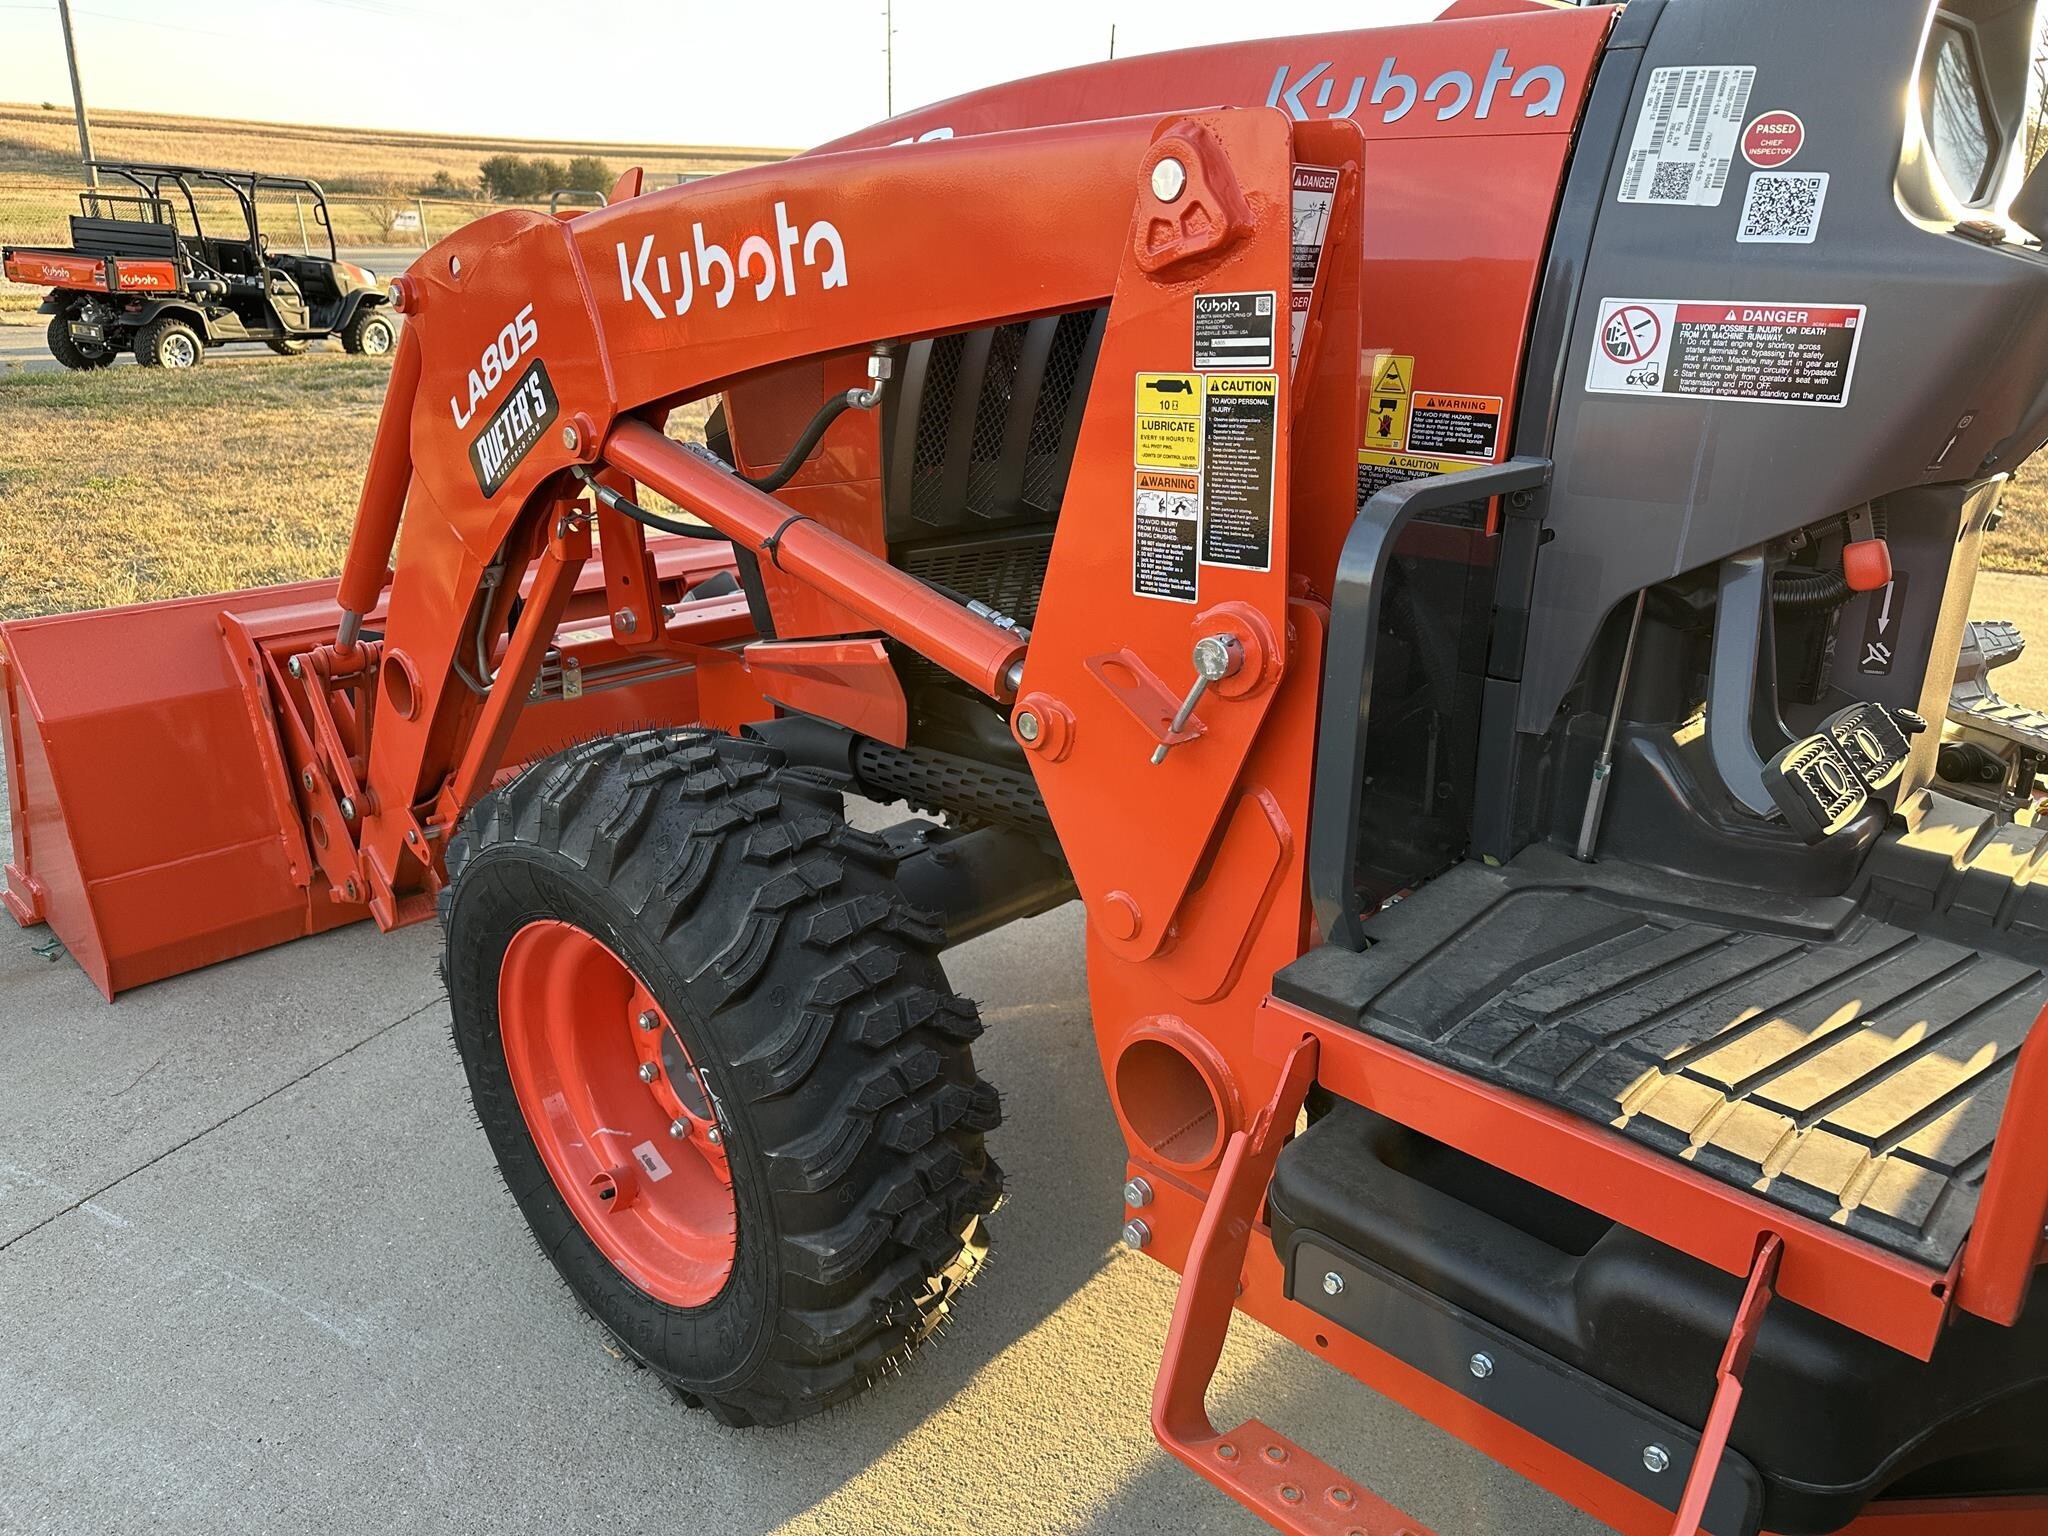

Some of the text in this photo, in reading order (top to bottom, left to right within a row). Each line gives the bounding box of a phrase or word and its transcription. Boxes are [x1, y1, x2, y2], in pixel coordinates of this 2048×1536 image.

[1265, 48, 1566, 123] Kubota
[1756, 124, 1796, 134] PASSED
[1302, 175, 1335, 188] DANGER
[616, 201, 848, 319] Kubota
[42, 265, 70, 278] Kubota
[121, 274, 158, 284] Kubota
[1196, 298, 1239, 312] Kubota
[1292, 296, 1308, 307] GER
[1742, 309, 1808, 323] DANGER
[1757, 326, 1783, 334] INJURY
[1747, 333, 1784, 341] RUNAWAY.
[1768, 342, 1794, 350] shorting
[1752, 348, 1785, 358] bypassing
[1803, 351, 1824, 360] safety
[451, 302, 538, 430] LA805
[1736, 365, 1760, 374] starting
[1803, 368, 1837, 376] bypassed.
[1221, 381, 1272, 392] CAUTION
[1680, 378, 1720, 386] transmission
[1760, 390, 1789, 399] standing
[1160, 400, 1170, 410] 10
[1438, 399, 1486, 410] WARNING
[476, 370, 546, 486] RUETER'S
[1142, 420, 1195, 432] LUBRICATE
[497, 423, 540, 479] RUETERCO.COM
[1400, 458, 1439, 470] CAUTION
[1374, 466, 1405, 475] PERSONAL
[1149, 476, 1195, 490] WARNING
